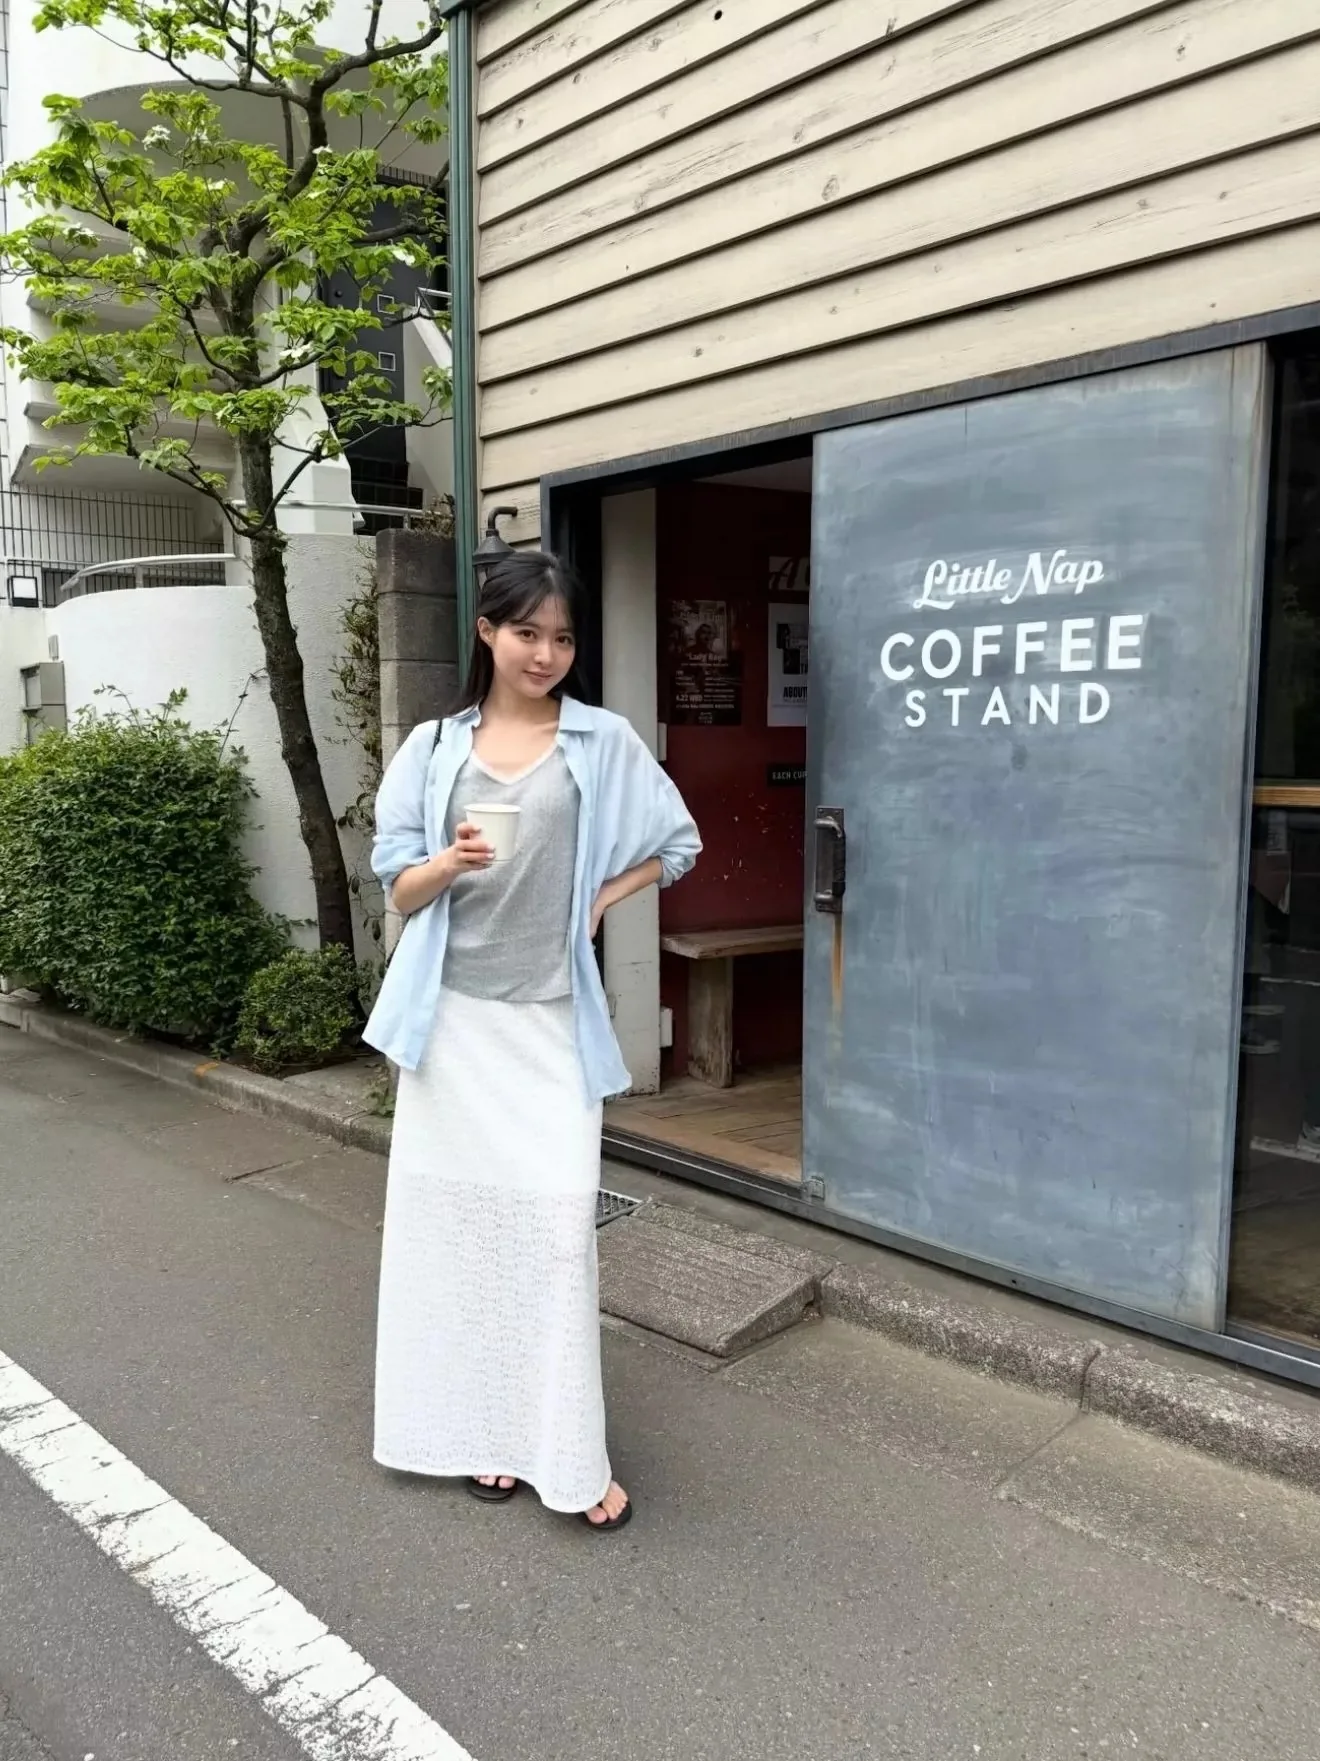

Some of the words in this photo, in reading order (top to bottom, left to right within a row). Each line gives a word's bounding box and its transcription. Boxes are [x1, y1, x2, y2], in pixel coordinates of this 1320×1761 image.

[912, 558, 1012, 610] Little
[1000, 549, 1105, 605] Nap
[880, 614, 1144, 681] COFFEE
[904, 682, 1111, 728] STAND
